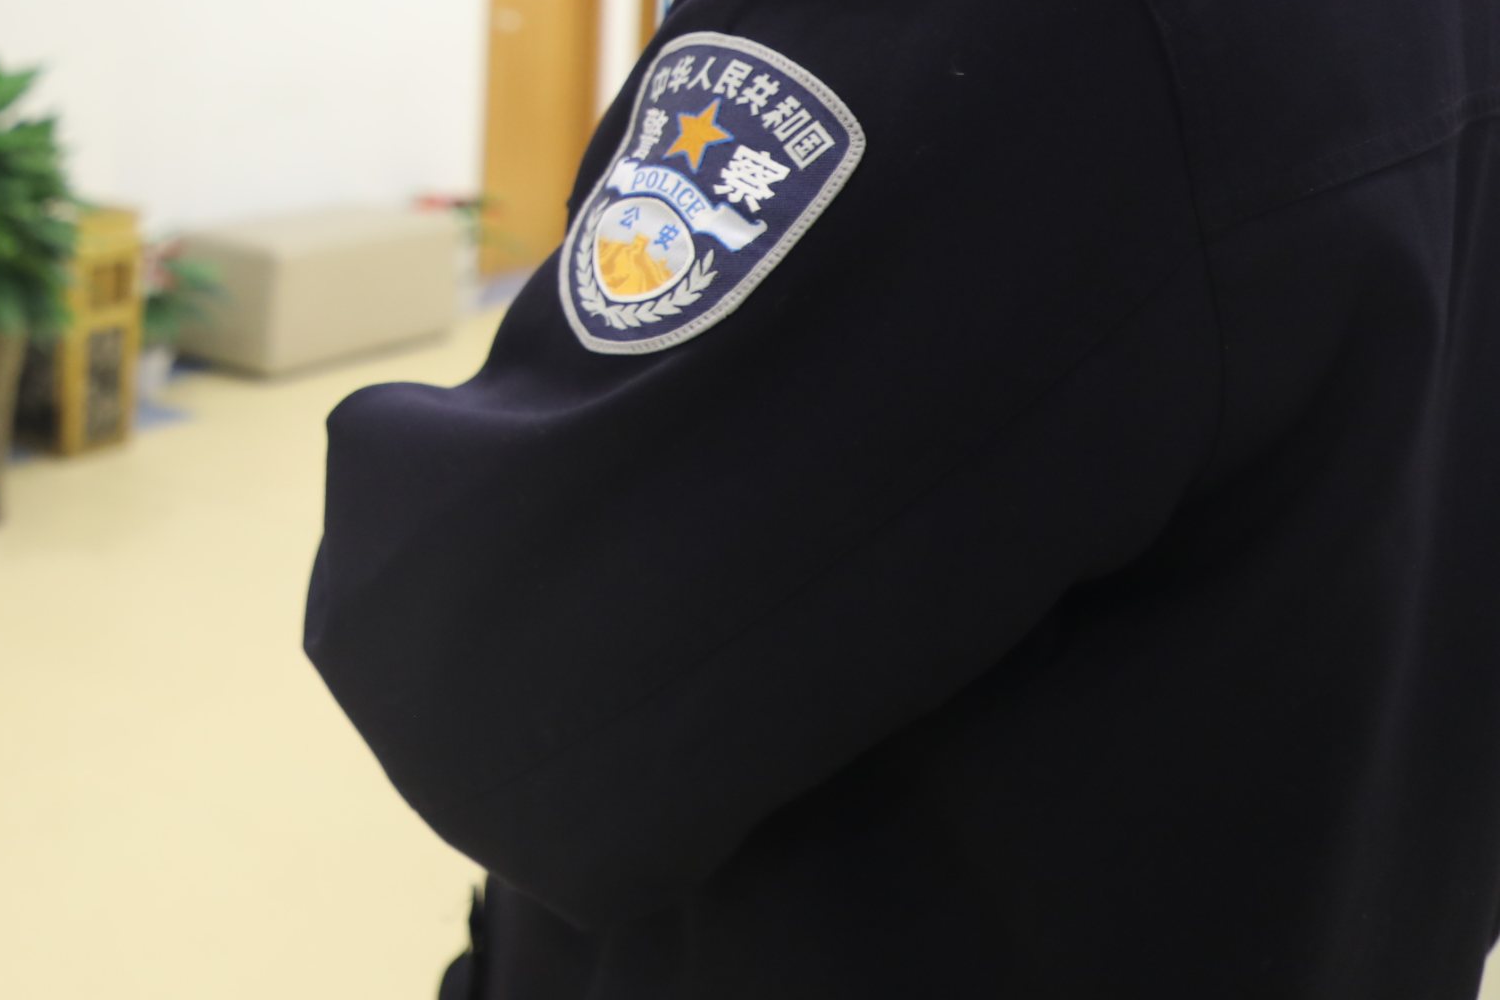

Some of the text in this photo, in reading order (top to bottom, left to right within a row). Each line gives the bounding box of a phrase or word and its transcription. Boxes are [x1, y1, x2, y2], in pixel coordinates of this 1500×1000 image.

[650, 55, 836, 170] 中华人民共和国
[631, 168, 706, 222] POLICE
